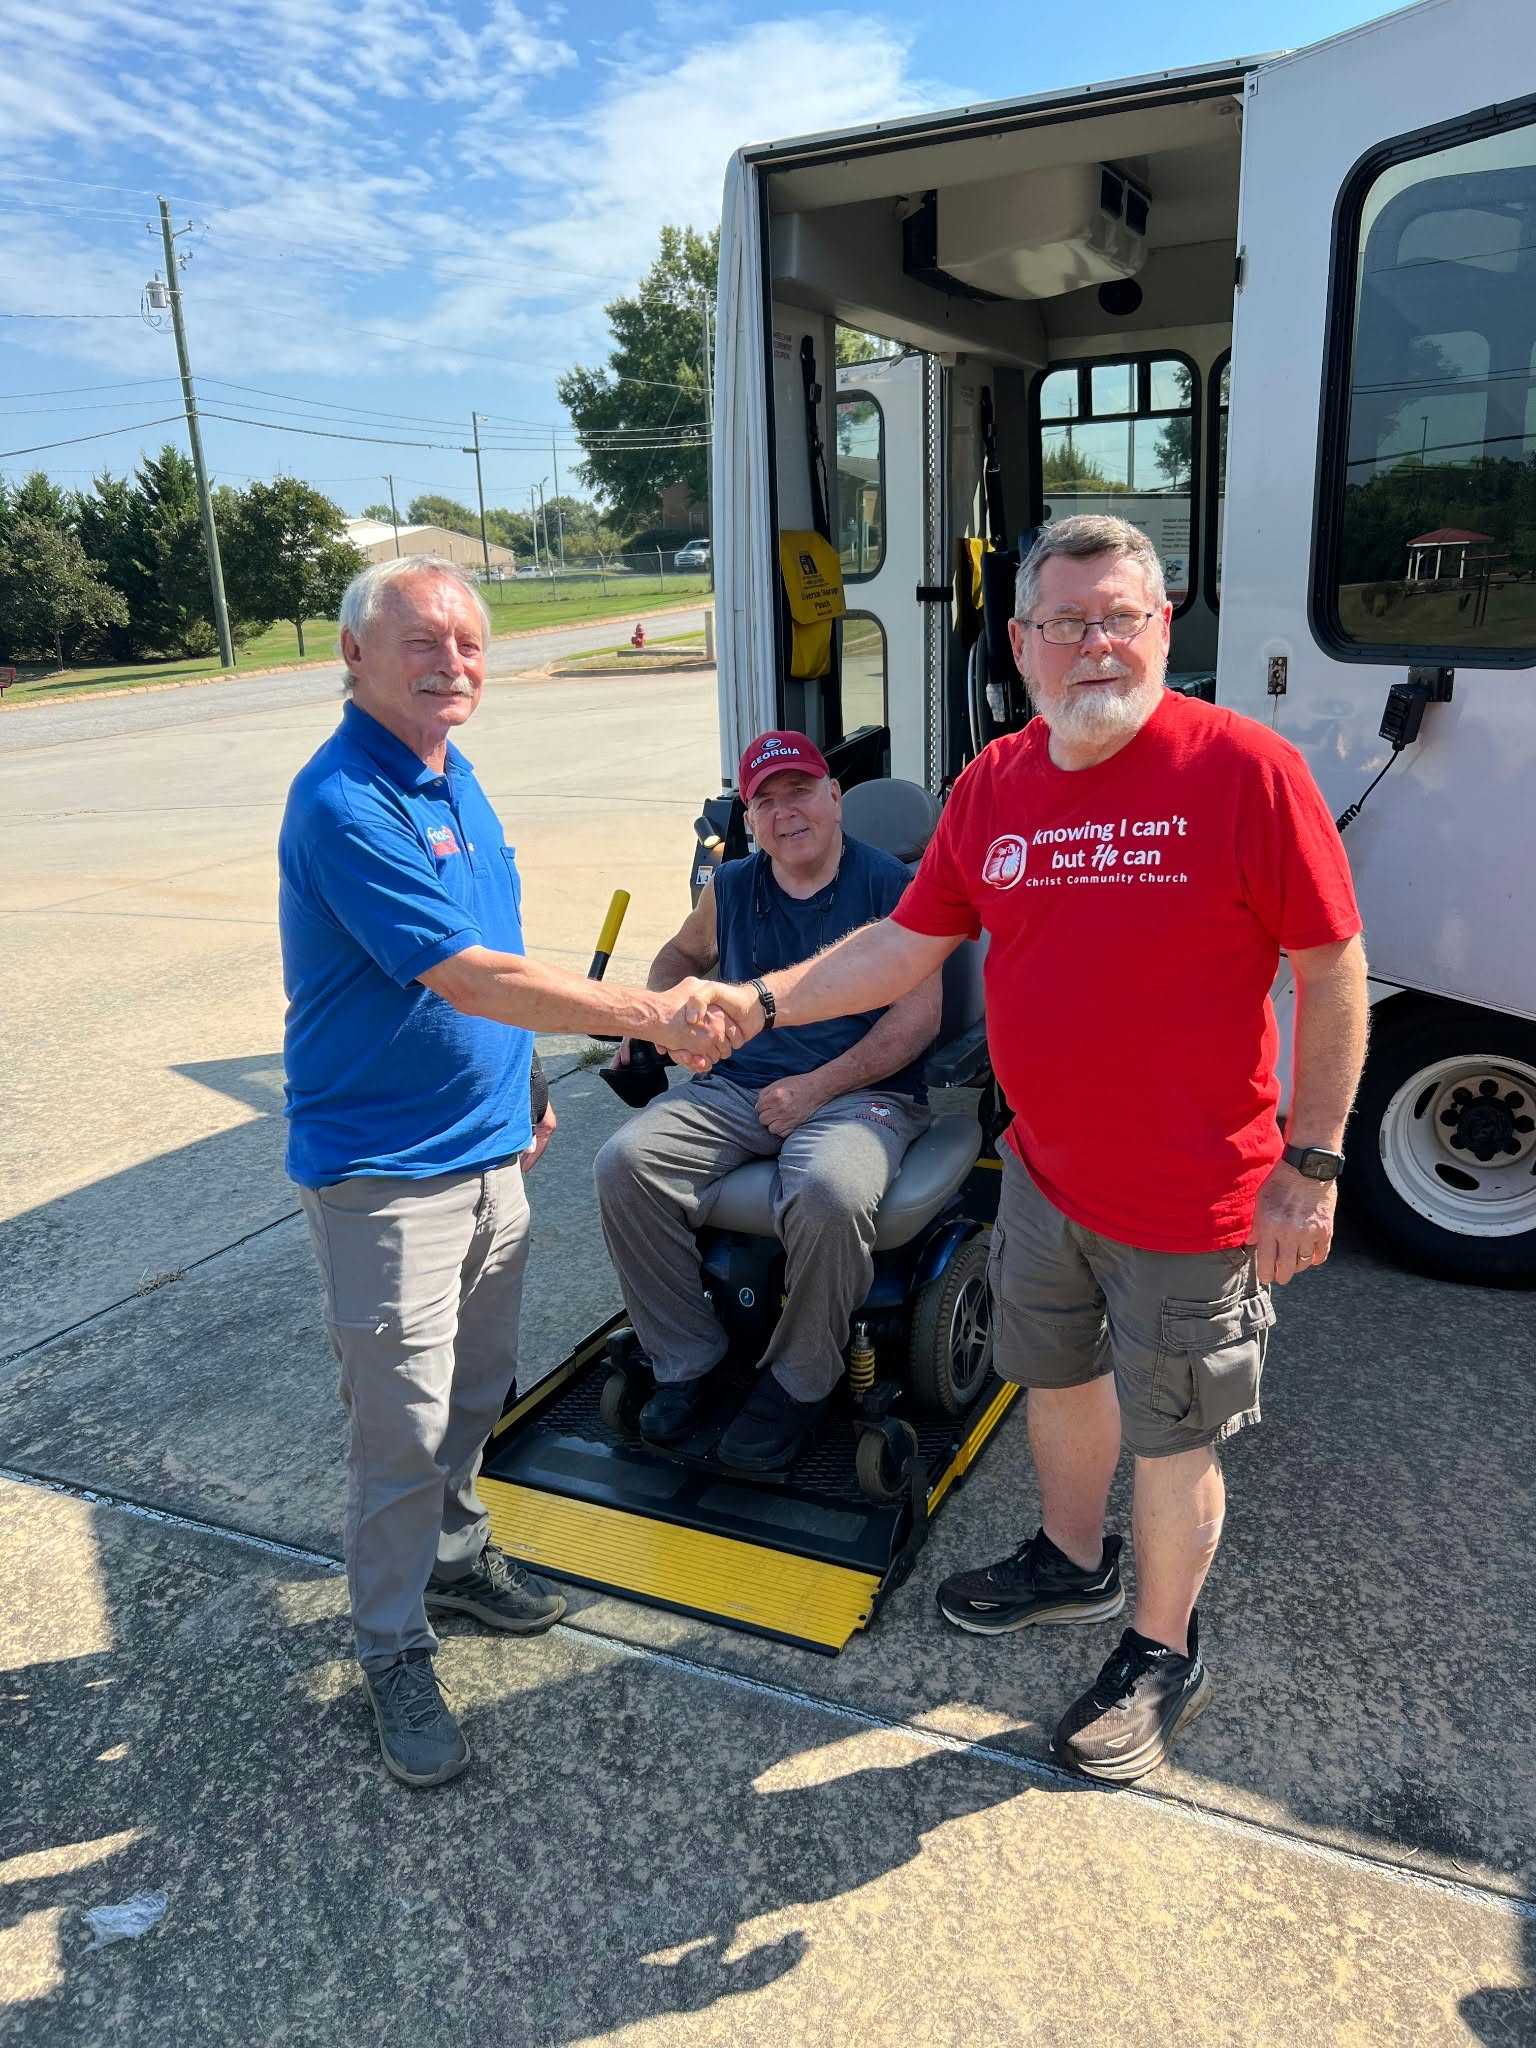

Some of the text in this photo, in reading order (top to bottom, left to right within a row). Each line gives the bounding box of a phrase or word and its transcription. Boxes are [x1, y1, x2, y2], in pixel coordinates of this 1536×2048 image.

[751, 747, 800, 768] GEORGIA
[1032, 815, 1188, 846] knowing I can't
[1051, 844, 1161, 871] but He can
[1025, 872, 1188, 887] Christ Community Church
